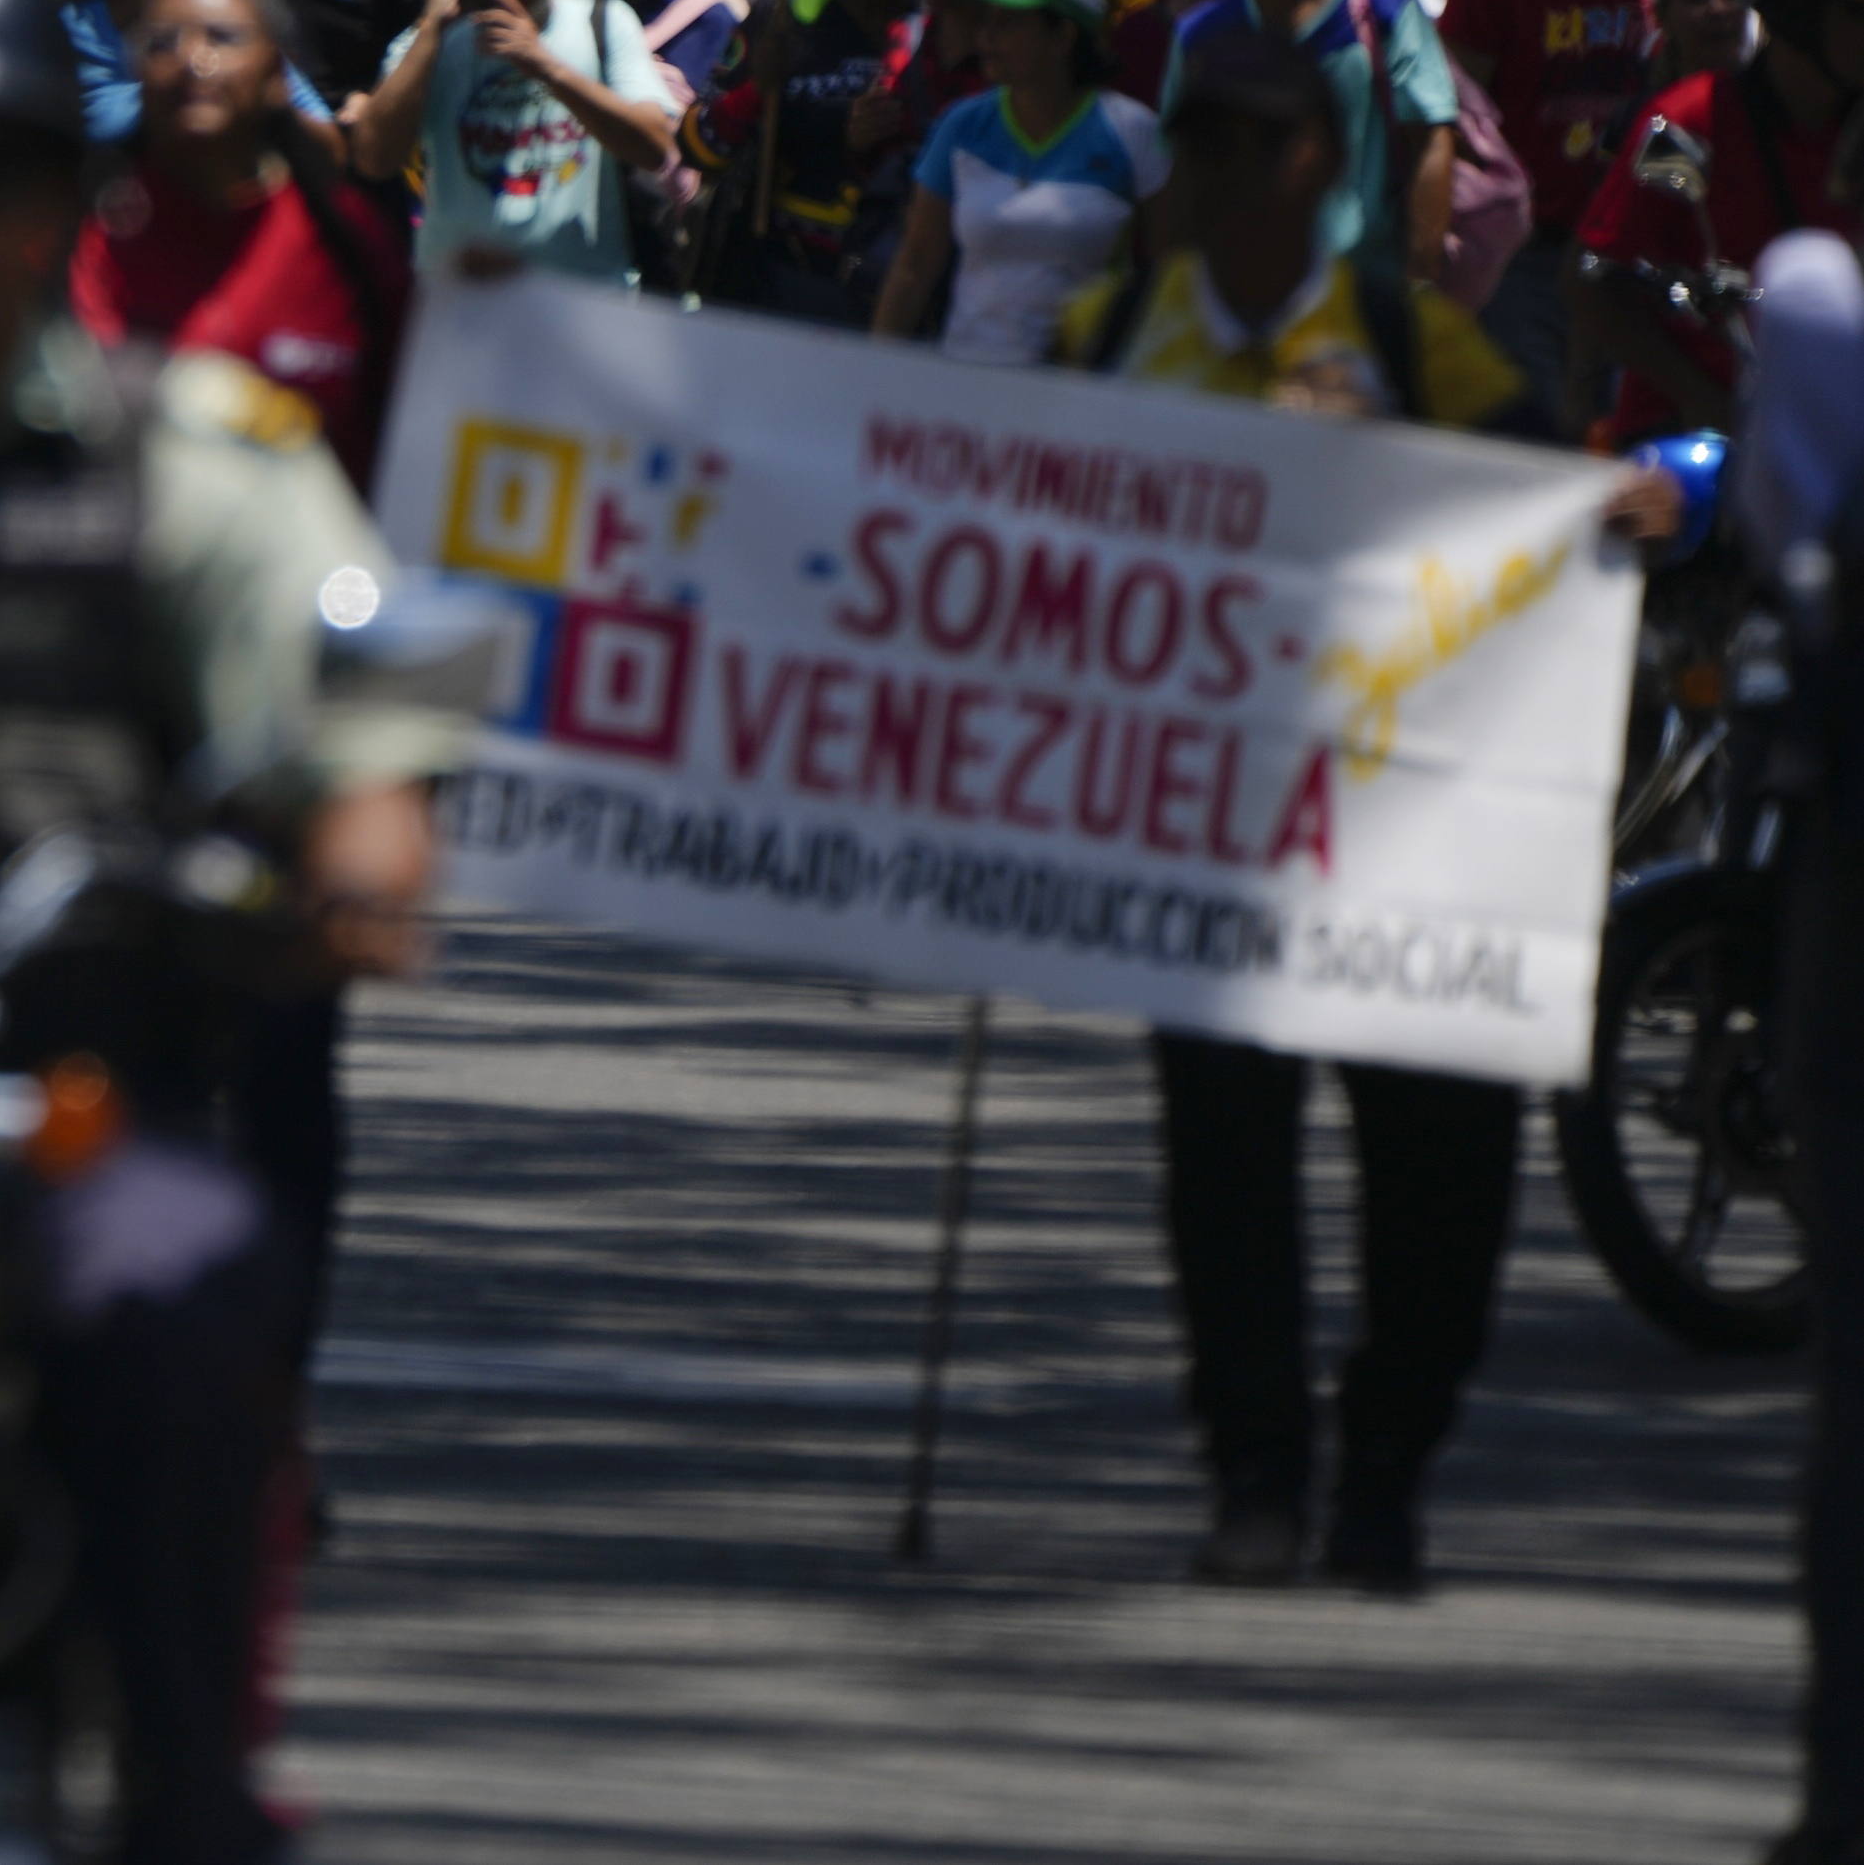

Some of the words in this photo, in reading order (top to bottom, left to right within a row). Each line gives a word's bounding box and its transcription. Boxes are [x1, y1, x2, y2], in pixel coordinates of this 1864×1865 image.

[858, 407, 1268, 554] MOVIMIENTO
[717, 642, 1339, 885] VENEZUELA
[1300, 908, 1543, 1016] SOCIAL
